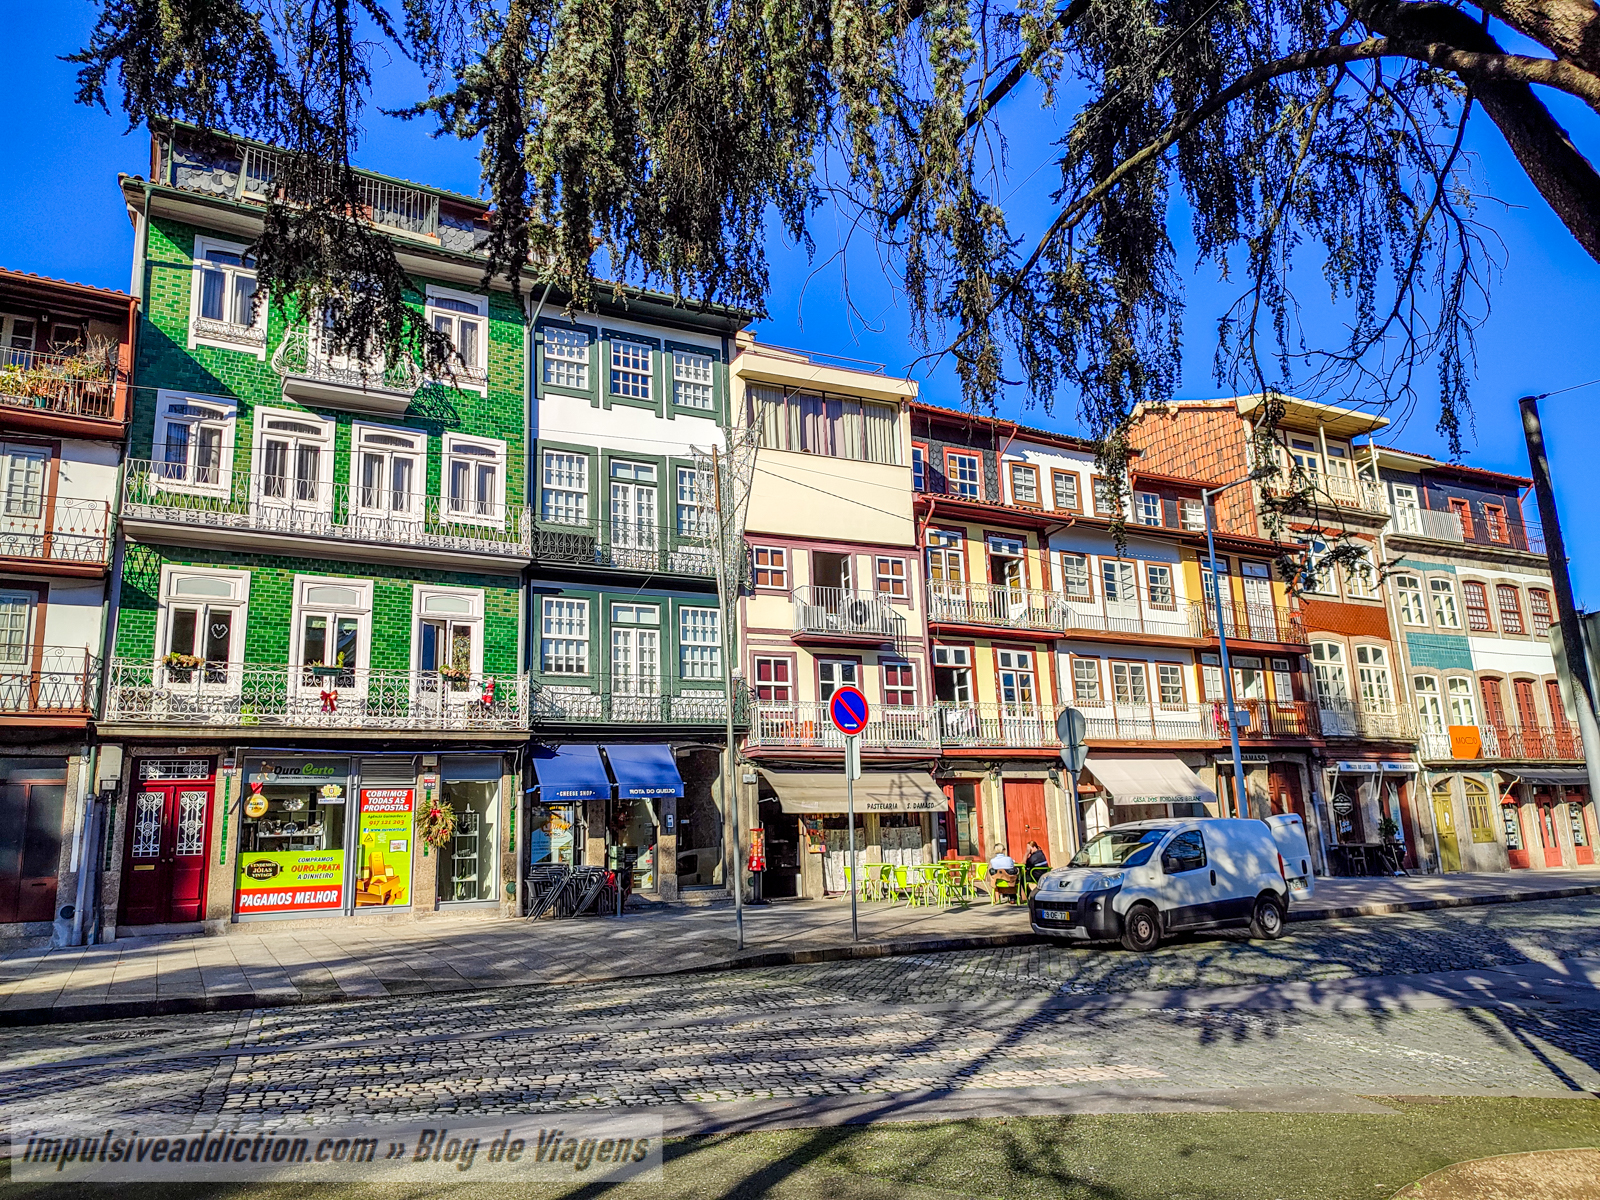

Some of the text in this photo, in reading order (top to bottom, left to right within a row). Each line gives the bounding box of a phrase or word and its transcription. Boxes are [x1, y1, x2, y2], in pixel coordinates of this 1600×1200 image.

[274, 763, 335, 775] Ouro Certo
[240, 890, 338, 907] PAGAMOS MELHOR
